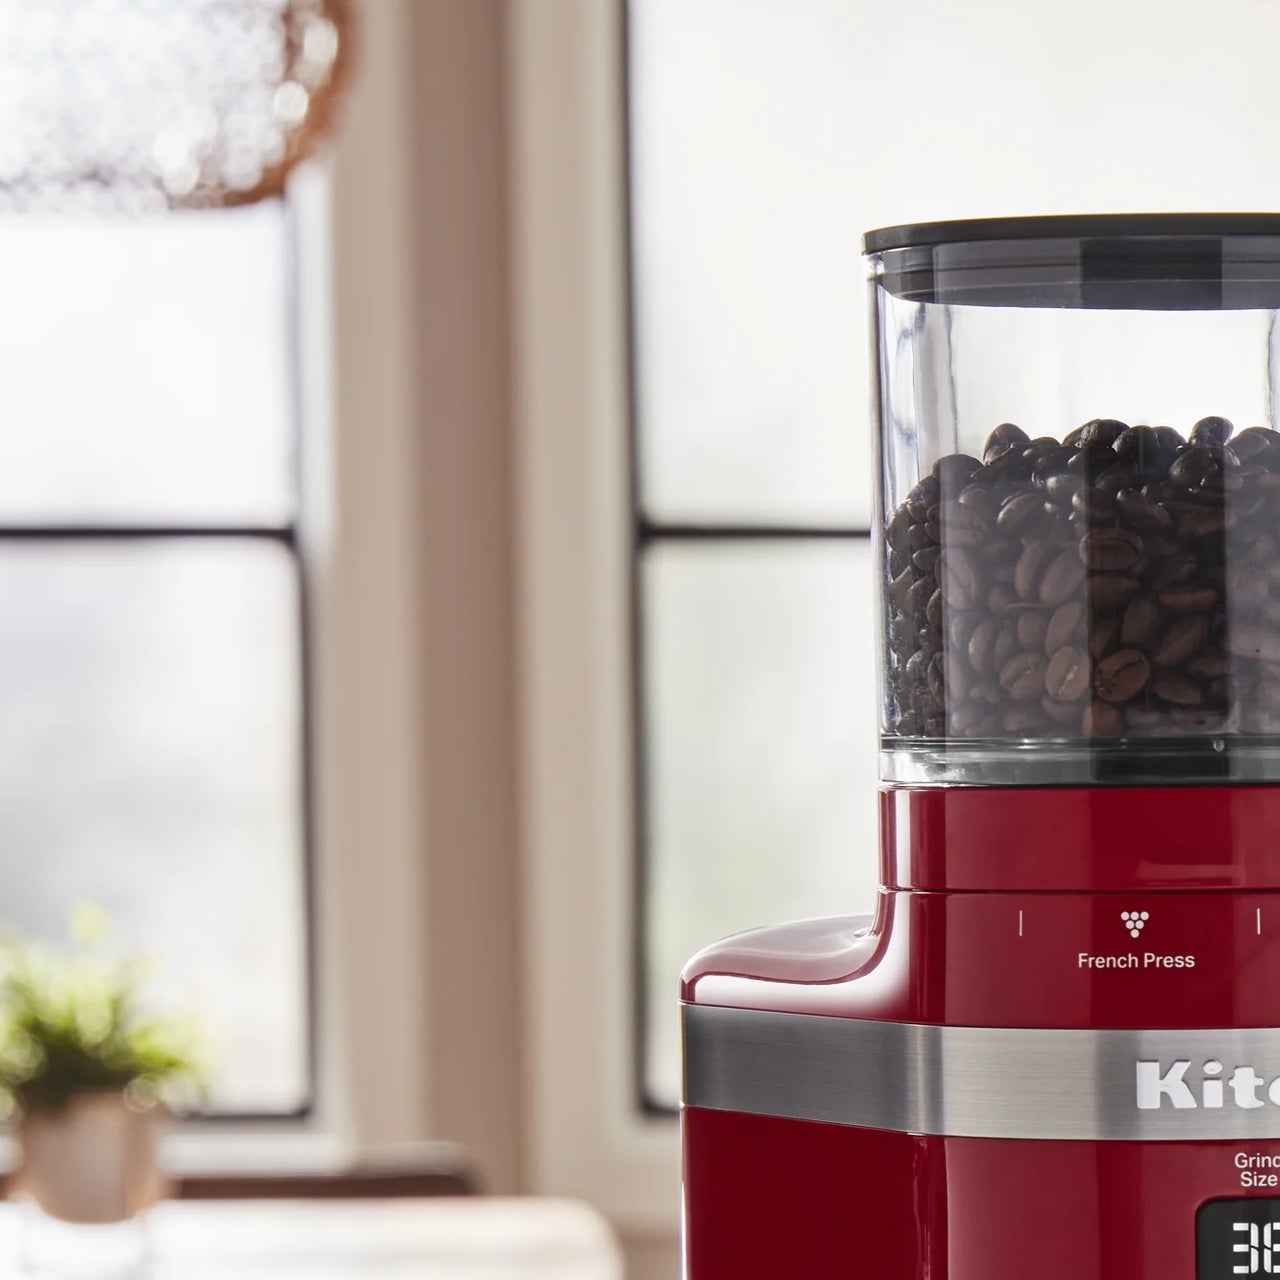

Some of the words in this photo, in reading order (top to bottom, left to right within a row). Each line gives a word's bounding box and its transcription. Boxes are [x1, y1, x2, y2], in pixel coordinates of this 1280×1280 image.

[1078, 952, 1139, 969] French
[1143, 952, 1195, 968] Press
[1240, 1171, 1278, 1187] Size
